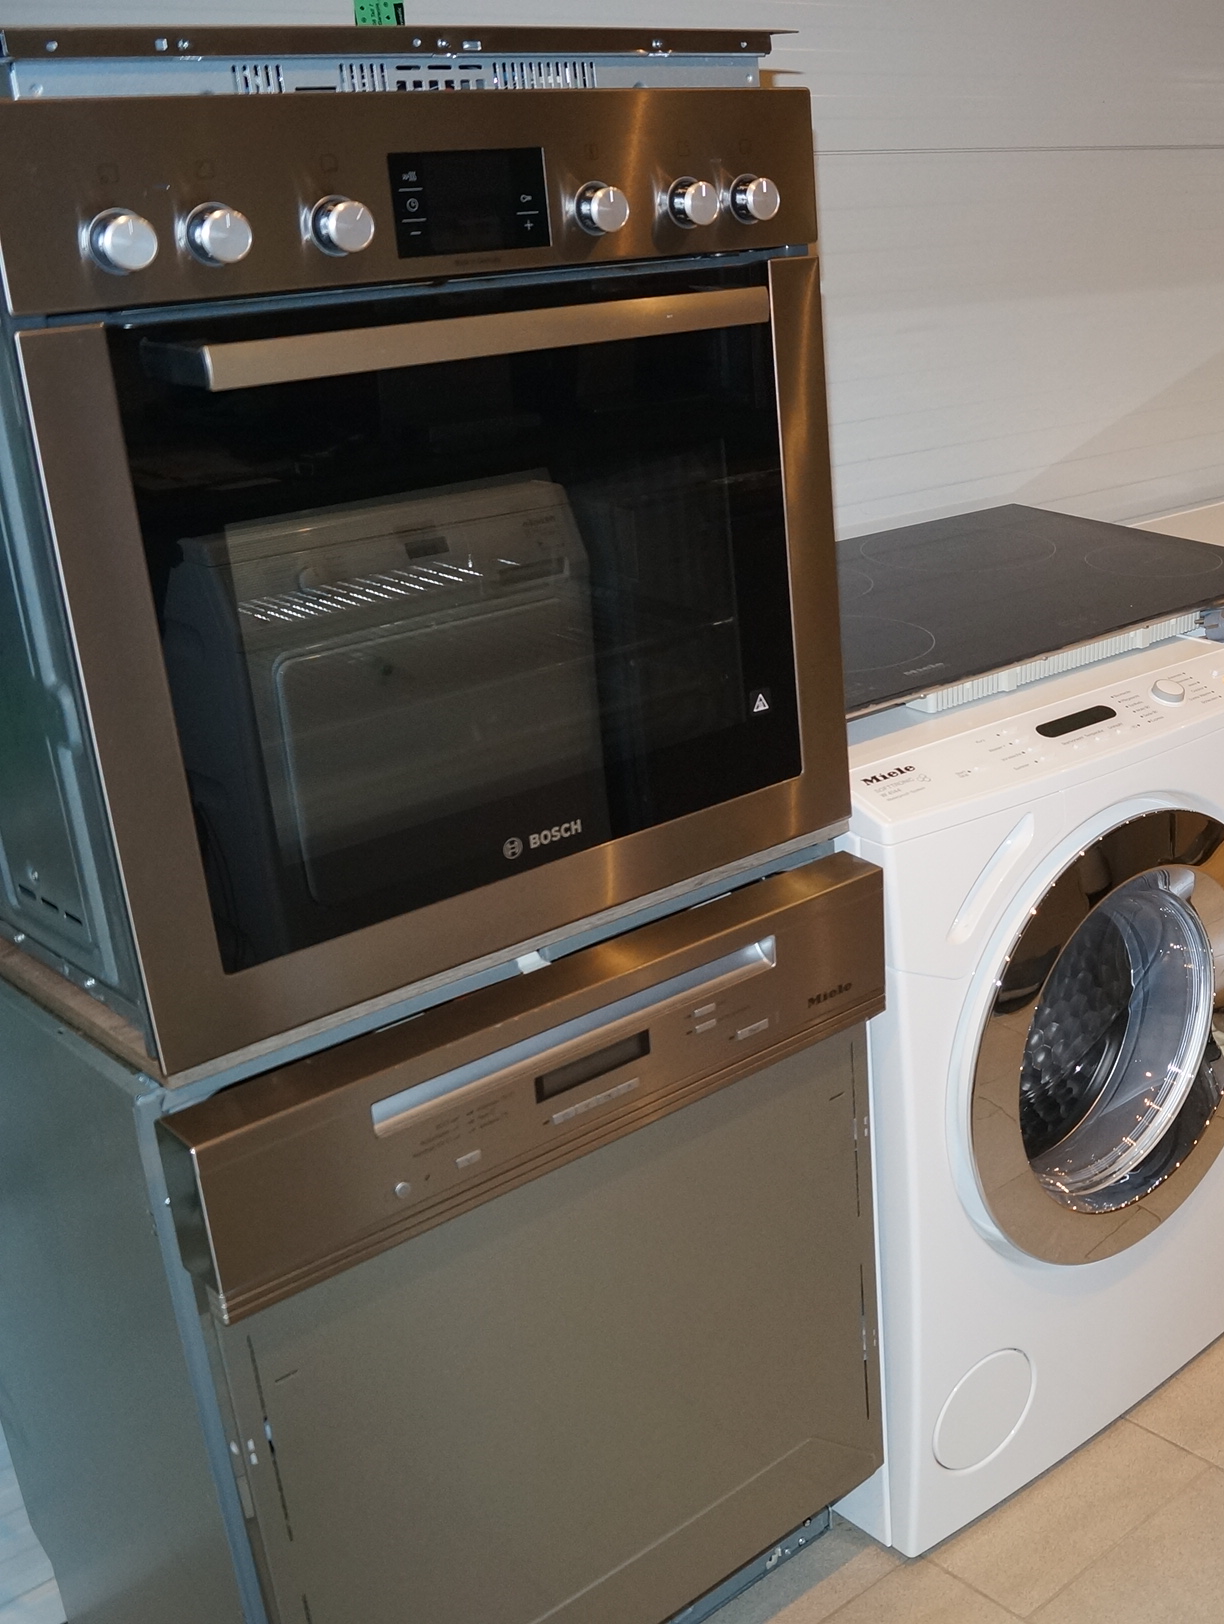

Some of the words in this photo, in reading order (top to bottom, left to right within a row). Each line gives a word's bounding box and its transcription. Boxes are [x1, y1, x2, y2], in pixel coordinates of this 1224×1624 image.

[860, 765, 916, 787] Miele
[528, 819, 582, 849] BOSCH
[807, 982, 853, 1009] Miele
